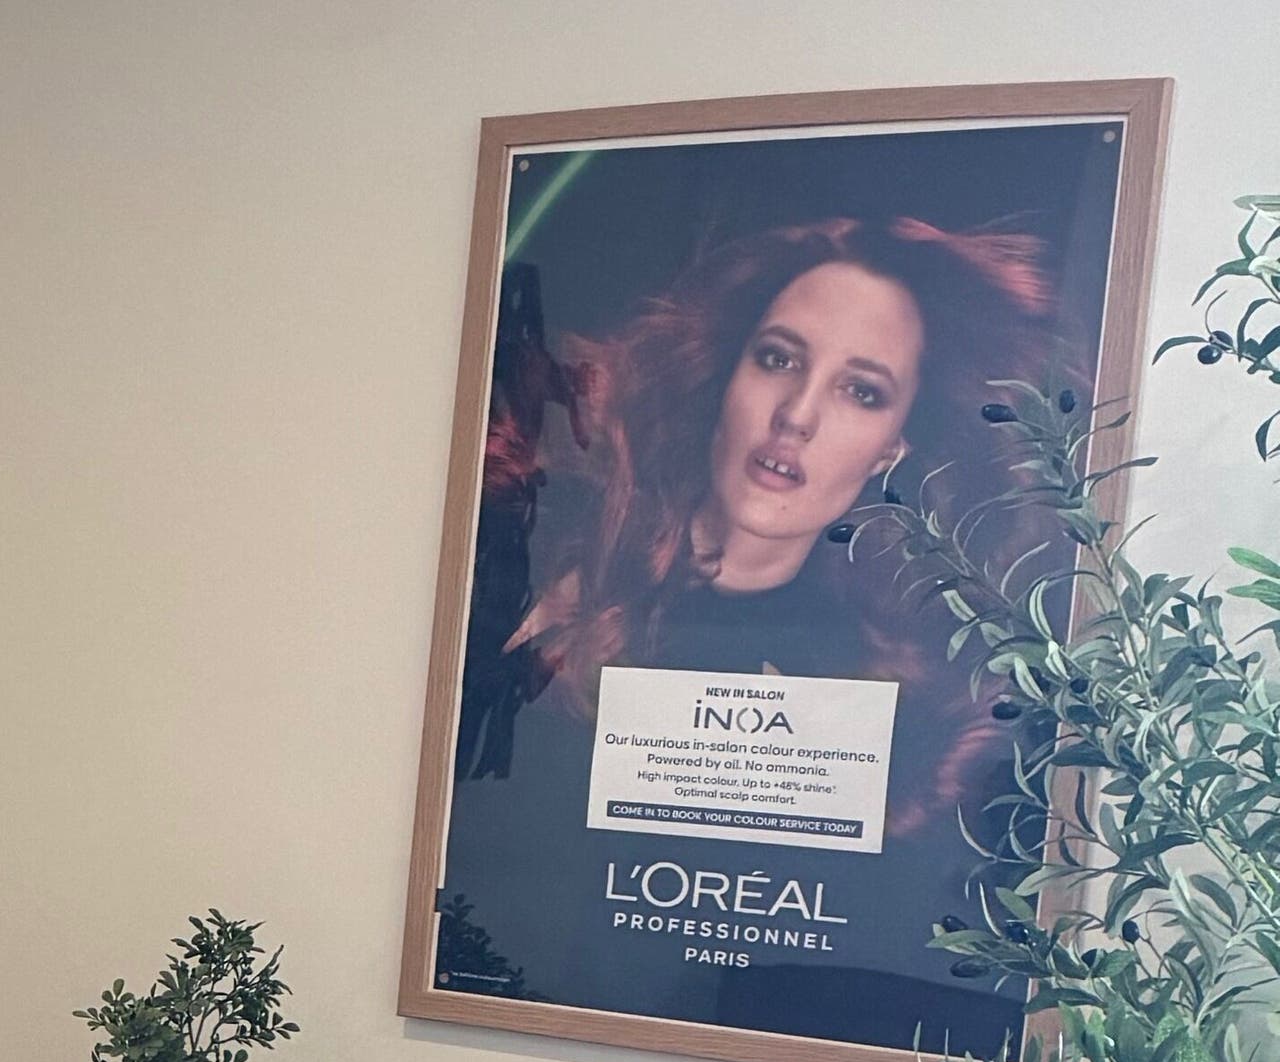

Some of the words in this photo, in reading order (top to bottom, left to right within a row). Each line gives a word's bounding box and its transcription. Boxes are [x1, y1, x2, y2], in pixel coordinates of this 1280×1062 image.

[705, 686, 731, 698] NEW
[732, 688, 745, 699] IN
[746, 689, 785, 701] SALON
[605, 733, 629, 746] Our
[631, 735, 690, 750] luxurious
[693, 739, 747, 753] in-salon
[751, 743, 794, 757] colour
[797, 747, 879, 764] experience.
[647, 753, 702, 768] Powered
[705, 757, 721, 771] by
[724, 759, 742, 770] oil.
[745, 761, 762, 772] No
[766, 763, 829, 777] ammonia.
[637, 770, 662, 783] High
[663, 772, 701, 785] impact
[742, 779, 758, 790] Up
[760, 780, 771, 789] to
[674, 787, 717, 799] Optimal
[719, 790, 749, 802] scalp
[751, 794, 797, 805] comfort.
[612, 804, 642, 815] COME
[645, 807, 655, 817] IN
[657, 809, 671, 818] TO
[672, 810, 702, 820] BOOK
[704, 812, 732, 823] YOUR
[733, 814, 777, 827] COLOUR
[779, 818, 821, 831] SERVICE
[823, 821, 857, 834] TODAY
[605, 861, 848, 924] L'ORÉAL
[613, 912, 834, 951] PROFESSIONNEL
[684, 947, 750, 968] PARIS
